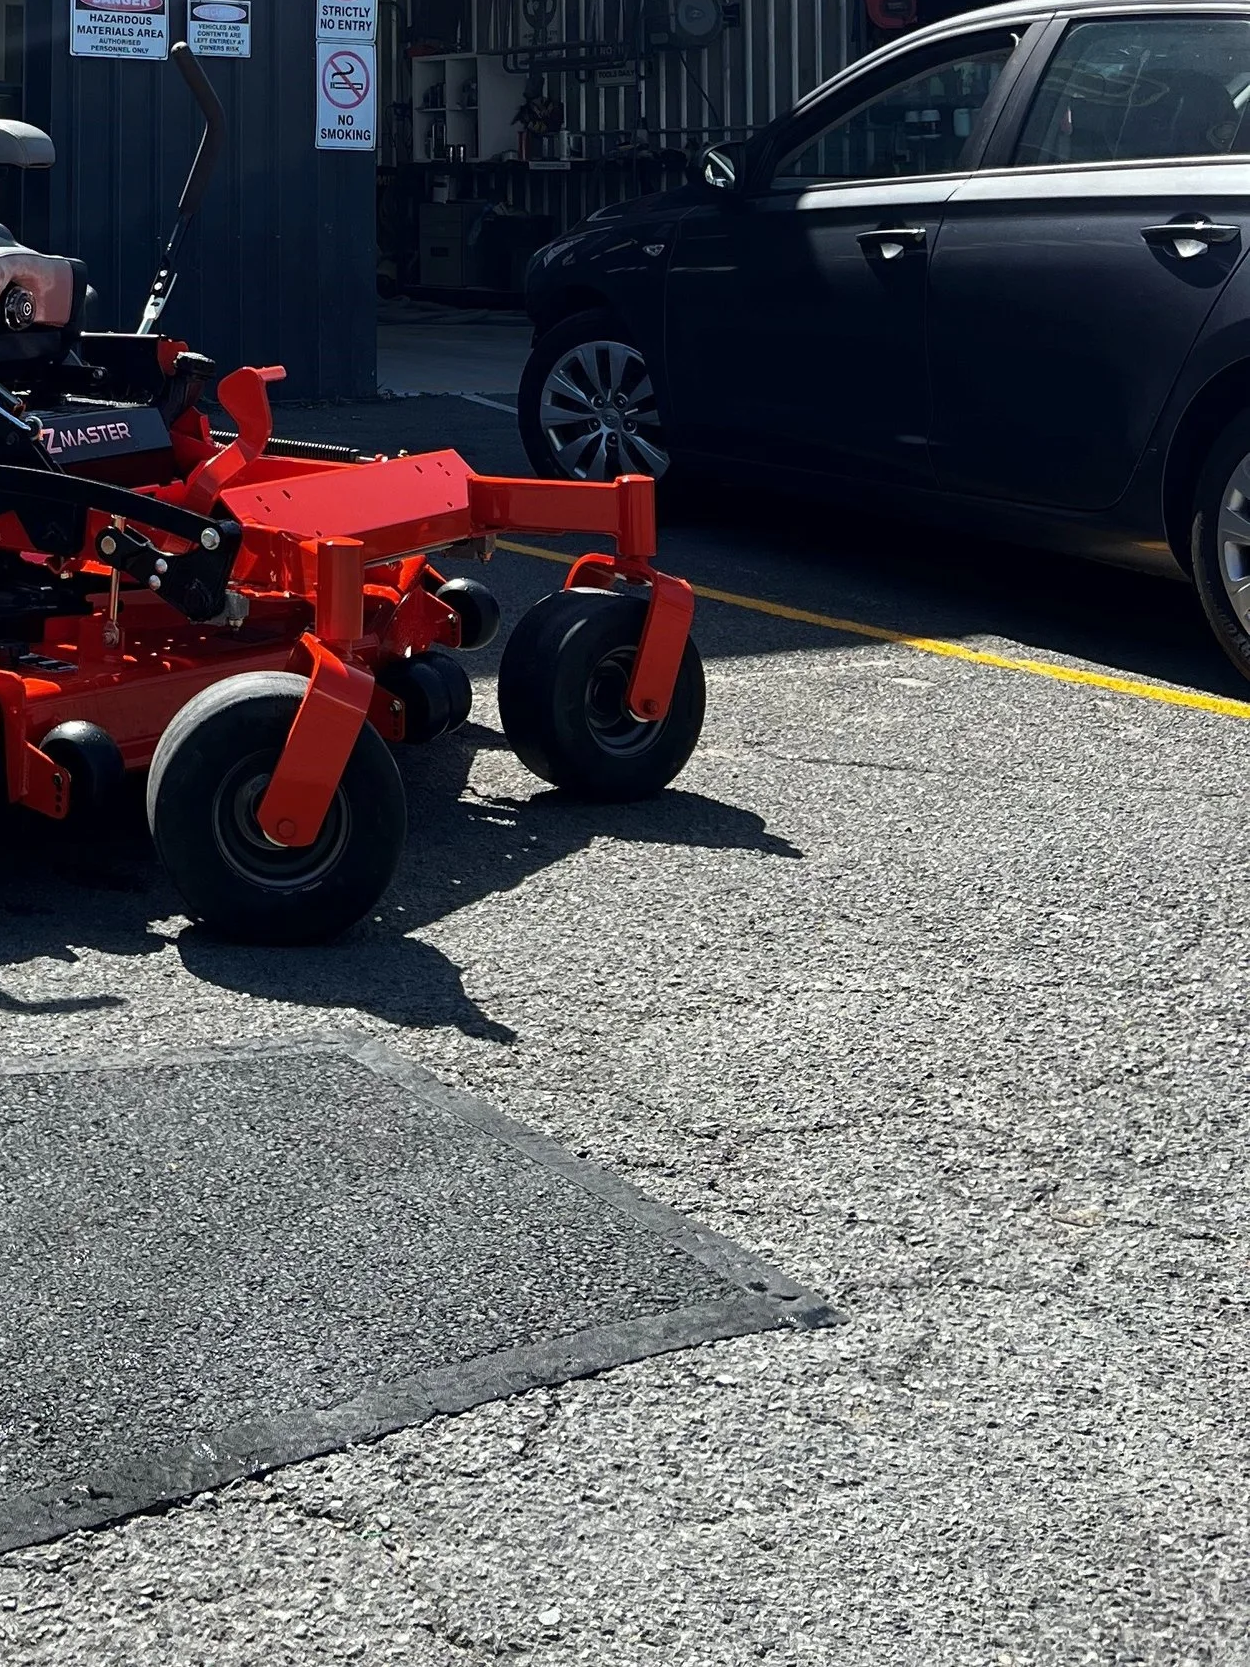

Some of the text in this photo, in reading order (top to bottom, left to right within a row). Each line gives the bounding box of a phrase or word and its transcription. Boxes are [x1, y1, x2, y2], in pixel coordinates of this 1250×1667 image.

[322, 5, 371, 18] STRICTLY
[89, 13, 152, 25] HAZARDOUS
[320, 19, 372, 32] NO ENTRY
[76, 25, 164, 38] MATERIALS AREA
[98, 38, 141, 46] AUTHORISED
[90, 45, 130, 53] PERSONNEL
[337, 115, 354, 127] NO
[320, 128, 371, 141] SMOKING
[39, 422, 132, 454] Z MASTER
